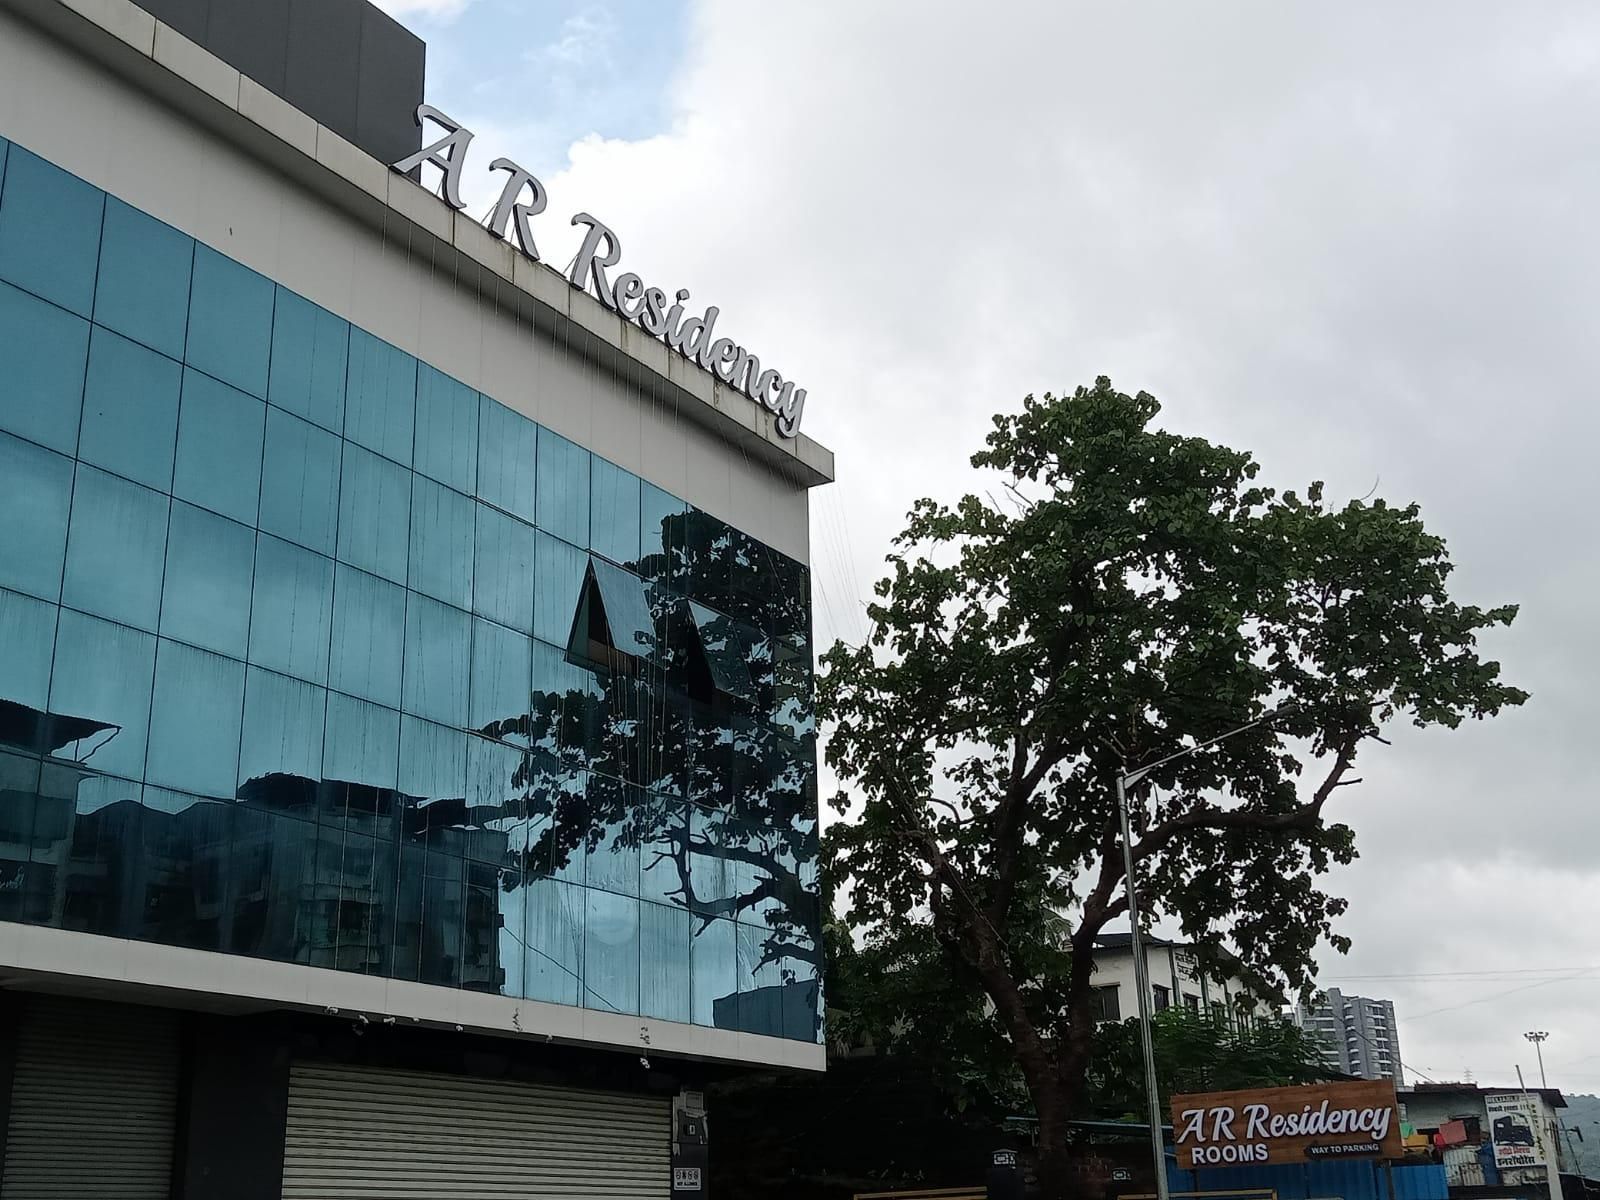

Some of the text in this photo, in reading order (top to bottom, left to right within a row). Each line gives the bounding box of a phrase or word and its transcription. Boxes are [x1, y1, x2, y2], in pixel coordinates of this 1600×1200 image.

[390, 103, 807, 439] A R Residency
[1177, 1099, 1392, 1143] A R Residency
[1191, 1143, 1268, 1164] ROOMS
[1331, 1146, 1341, 1154] TO
[1343, 1143, 1379, 1153] PARKING
